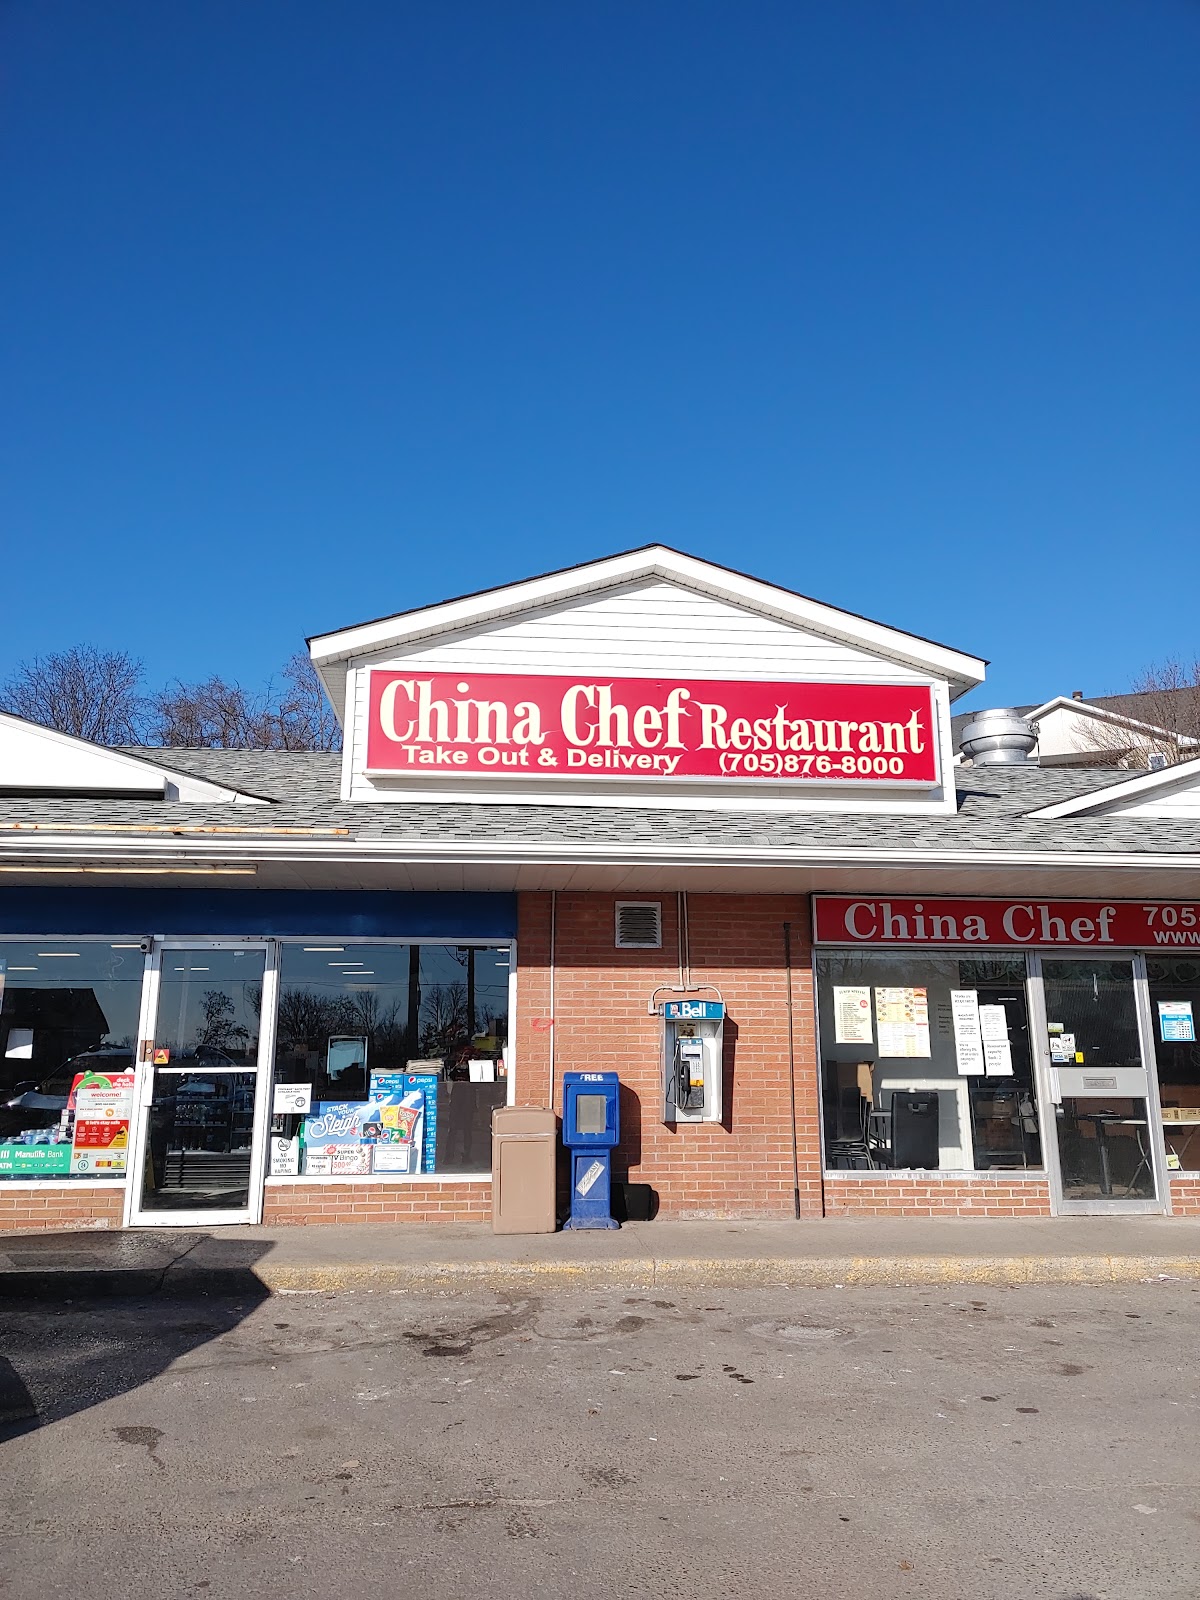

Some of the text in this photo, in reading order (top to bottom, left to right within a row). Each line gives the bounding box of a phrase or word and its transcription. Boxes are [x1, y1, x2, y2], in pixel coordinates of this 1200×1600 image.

[380, 678, 926, 754] China Chef Restaurant
[401, 744, 684, 775] Take Out & Delivery
[719, 752, 904, 775] (705)876-8000
[844, 902, 1117, 942] China Chef
[1142, 906, 1200, 927] 705
[682, 1002, 706, 1017] Bell
[327, 1104, 348, 1112] STACK
[310, 1111, 361, 1138] Sleigh
[15, 1150, 63, 1158] Manulife Bank
